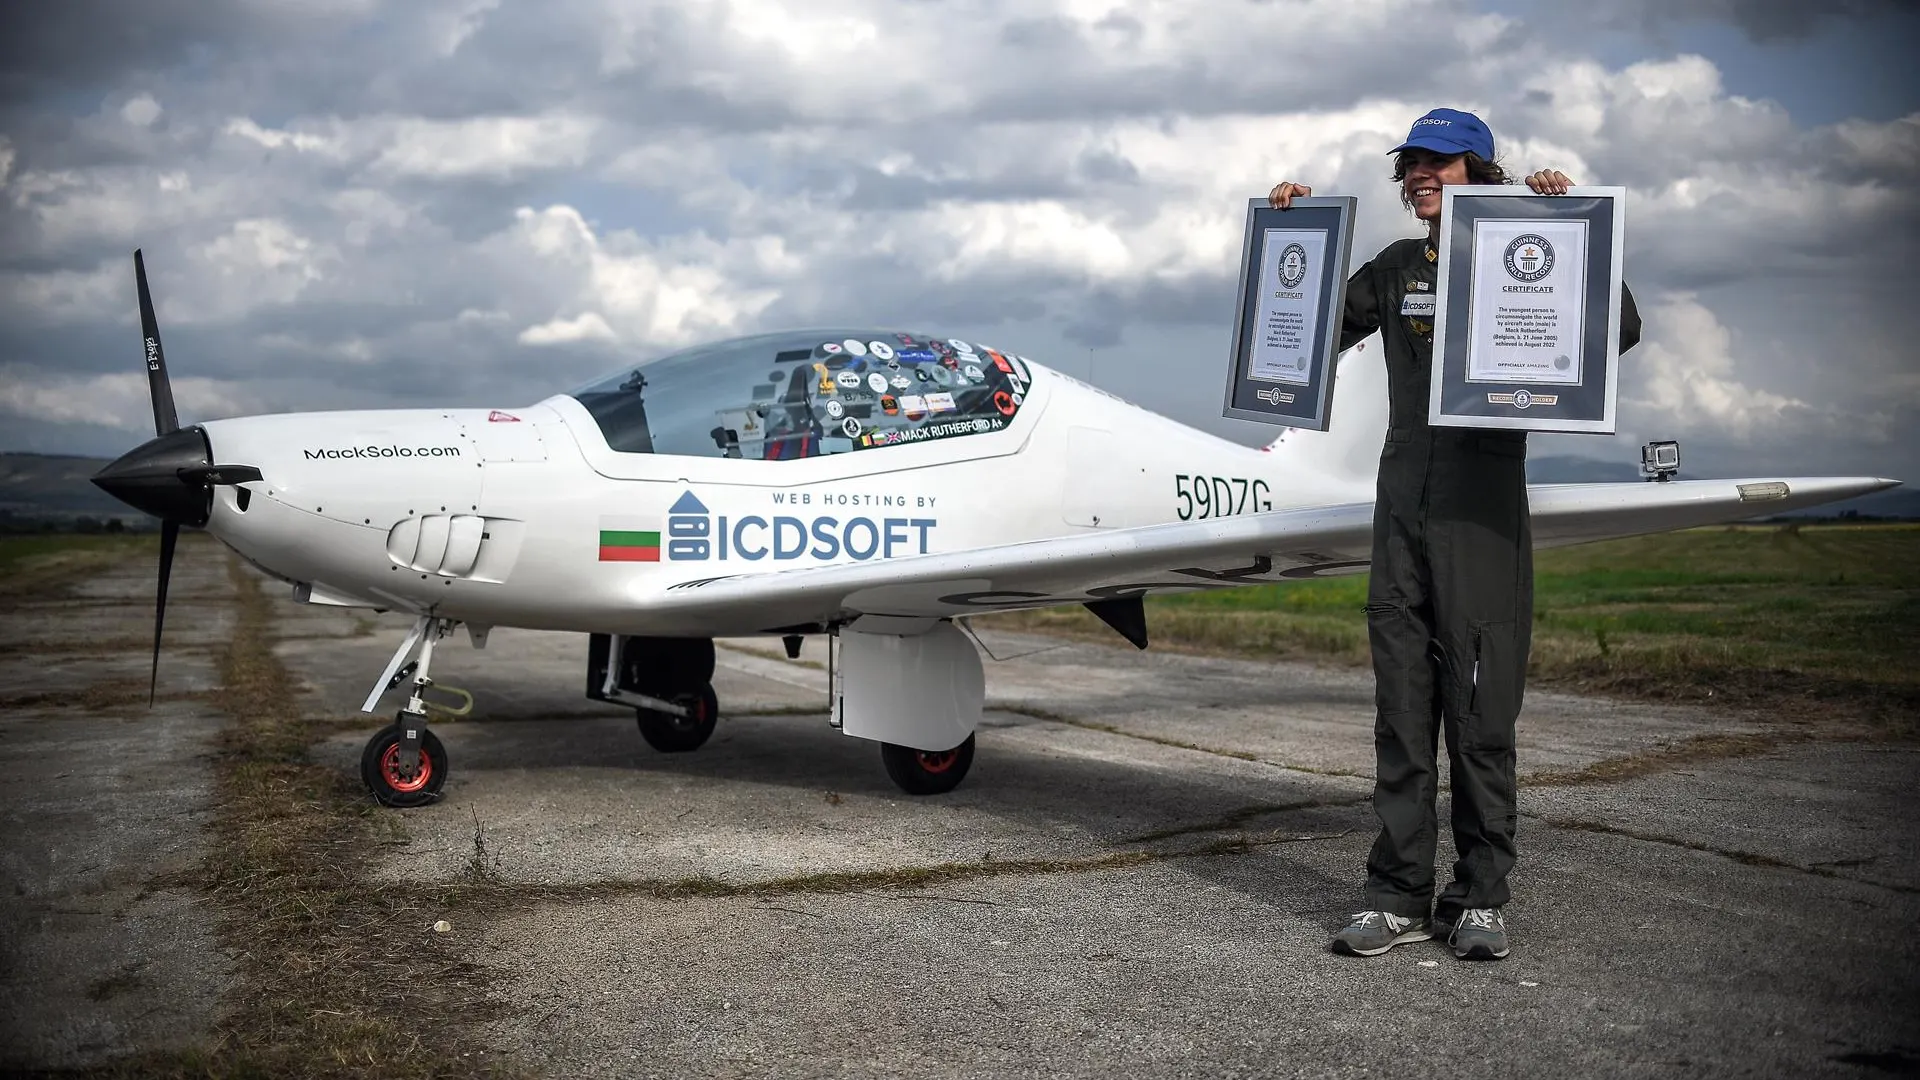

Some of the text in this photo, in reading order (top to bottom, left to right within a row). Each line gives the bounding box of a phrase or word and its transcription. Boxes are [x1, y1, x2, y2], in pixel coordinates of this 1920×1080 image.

[1511, 237, 1549, 250] GUINNESS
[1506, 254, 1553, 280] WORLD RECORDS
[1275, 291, 1304, 299] CERTIFICATE
[1502, 285, 1554, 293] CERTIFICATE
[900, 418, 1003, 442] MACK RUTHERFORD A+
[304, 445, 460, 459] MackSolo.com
[773, 493, 936, 508] WEB HOSTING BY
[719, 515, 937, 560] ICDSOFT
